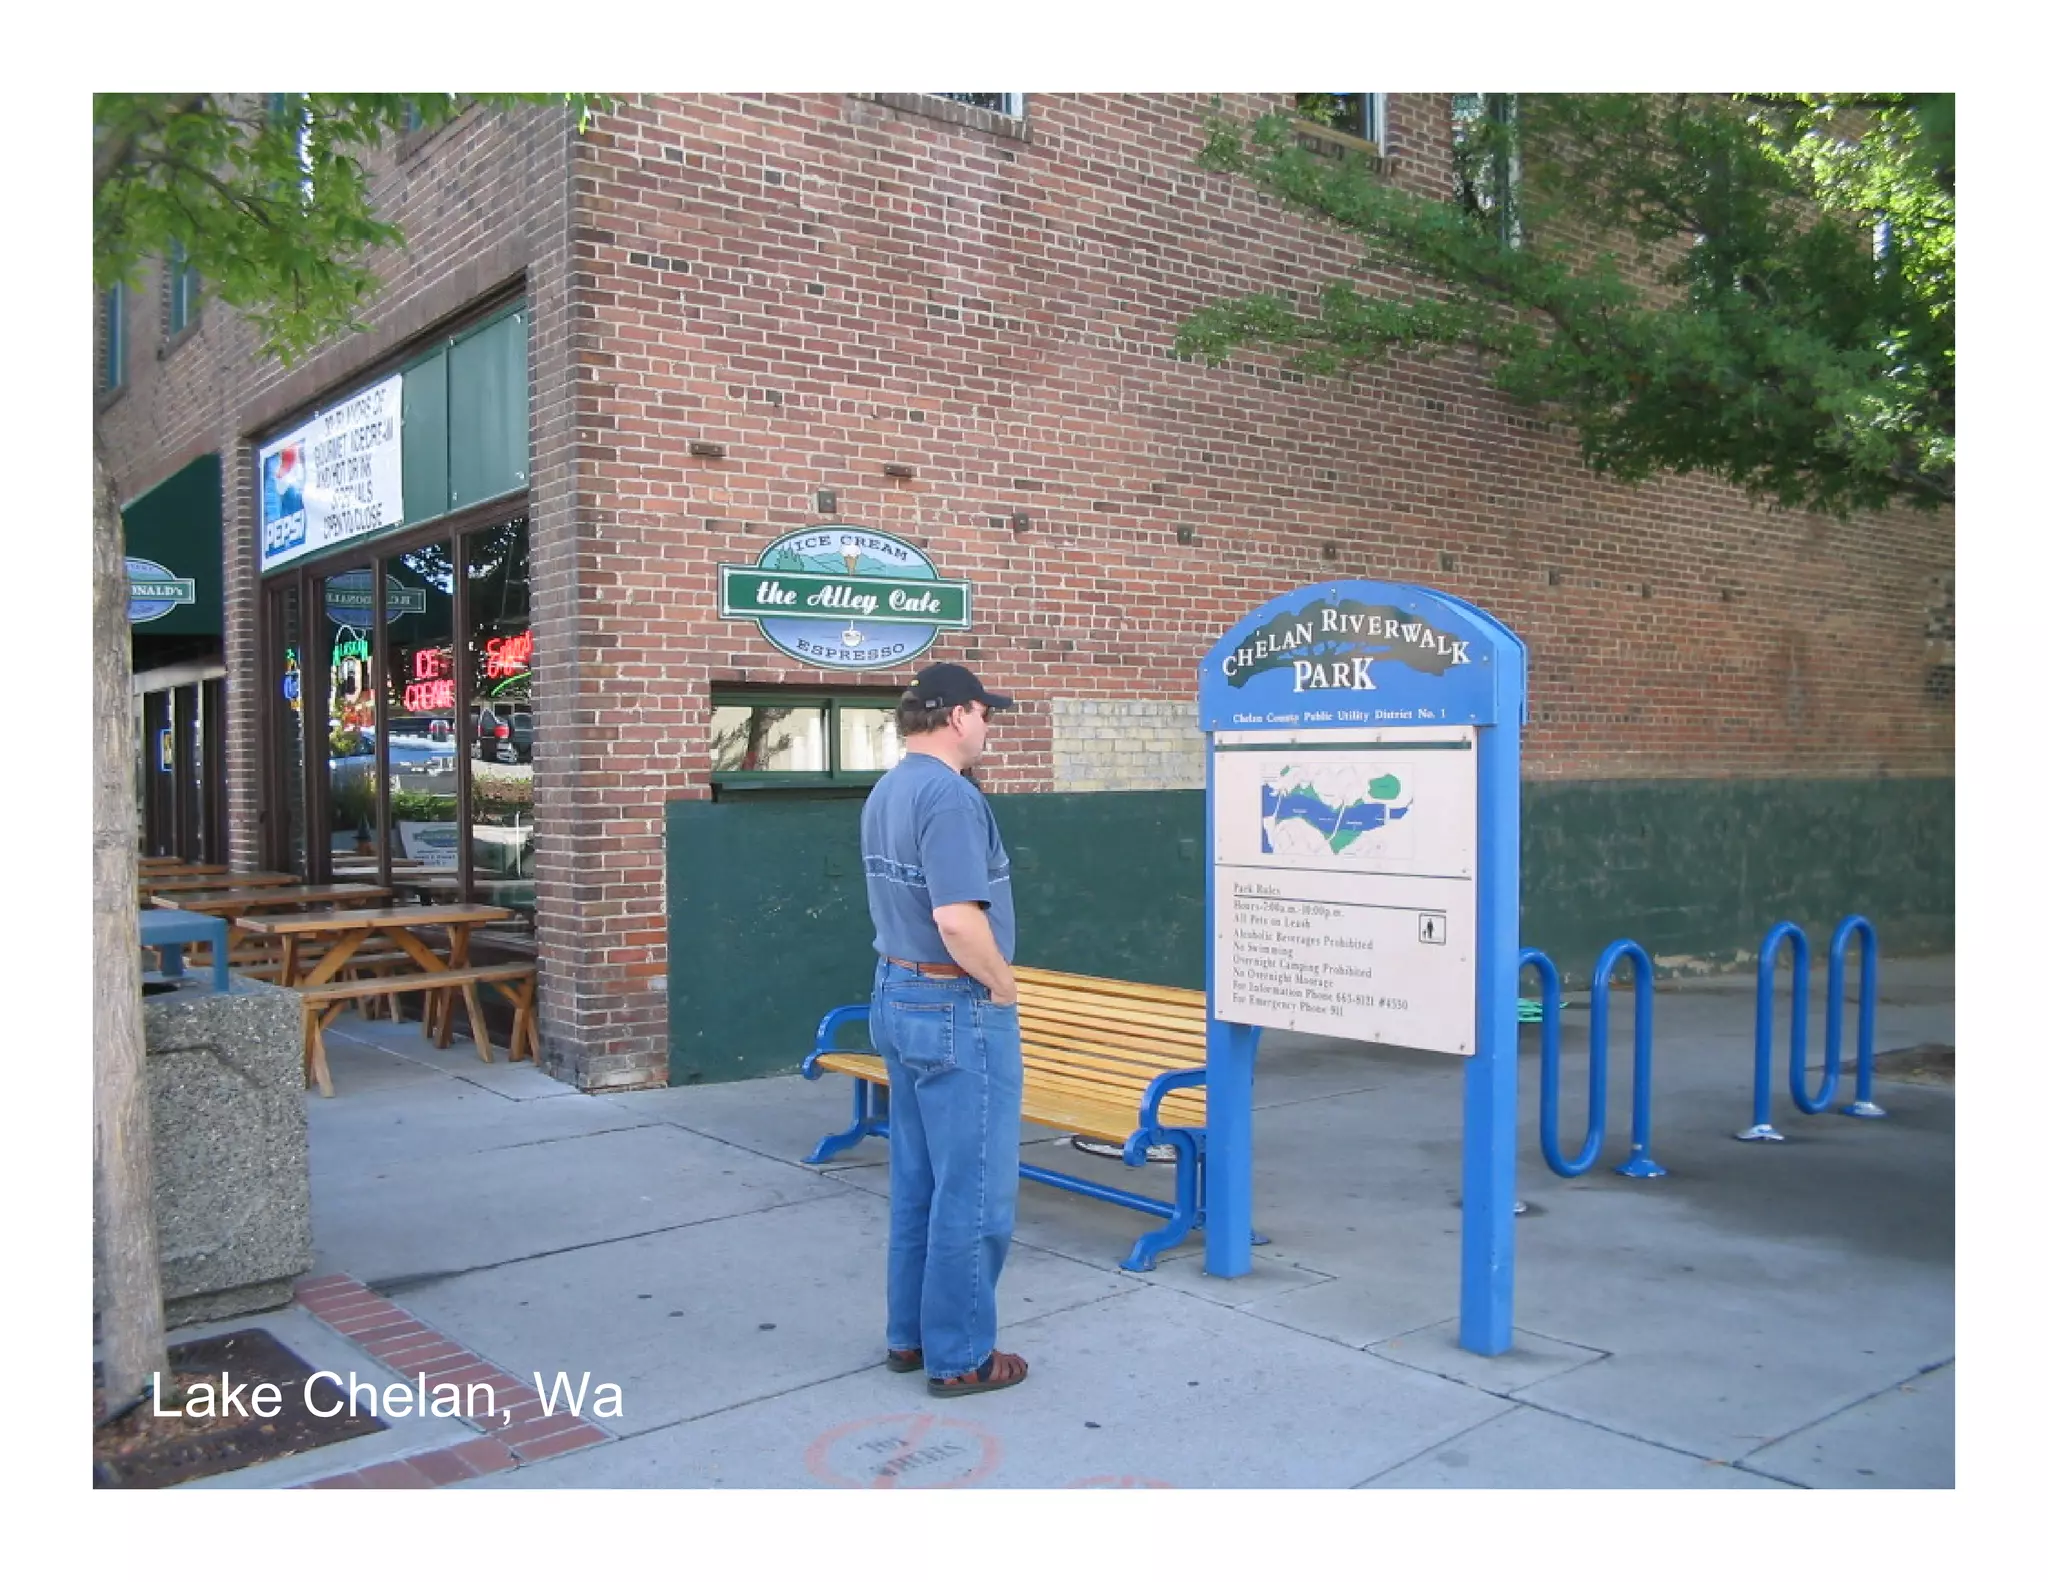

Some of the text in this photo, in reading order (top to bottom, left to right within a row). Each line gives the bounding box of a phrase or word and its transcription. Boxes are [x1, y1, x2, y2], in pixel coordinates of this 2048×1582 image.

[266, 510, 305, 552] PEPSI
[796, 534, 909, 563] ICE CREAM
[756, 581, 942, 616] the Alley Cafe
[796, 637, 905, 661] ESPRESSO
[1222, 608, 1472, 676] CHELAN RIVERWALK
[1293, 656, 1377, 693] PARK
[1232, 708, 1446, 725] Chelan County Public Utility District No. 1
[1233, 881, 1281, 895] Park Rules
[1233, 912, 1247, 925] All
[1251, 914, 1268, 925] Pets
[1283, 915, 1311, 929] Leash
[1233, 927, 1374, 950] Alcoholic Beverages Prohibited
[1233, 940, 1294, 959] No Swimming
[1233, 954, 1372, 979] Overnight Camping Prohibited
[1233, 966, 1245, 978] No
[1247, 968, 1292, 986] Overnight
[1233, 979, 1247, 990] For
[1248, 981, 1303, 998] Information
[1305, 988, 1333, 1002] Phone
[1232, 992, 1344, 1017] For Emergency Phone 911
